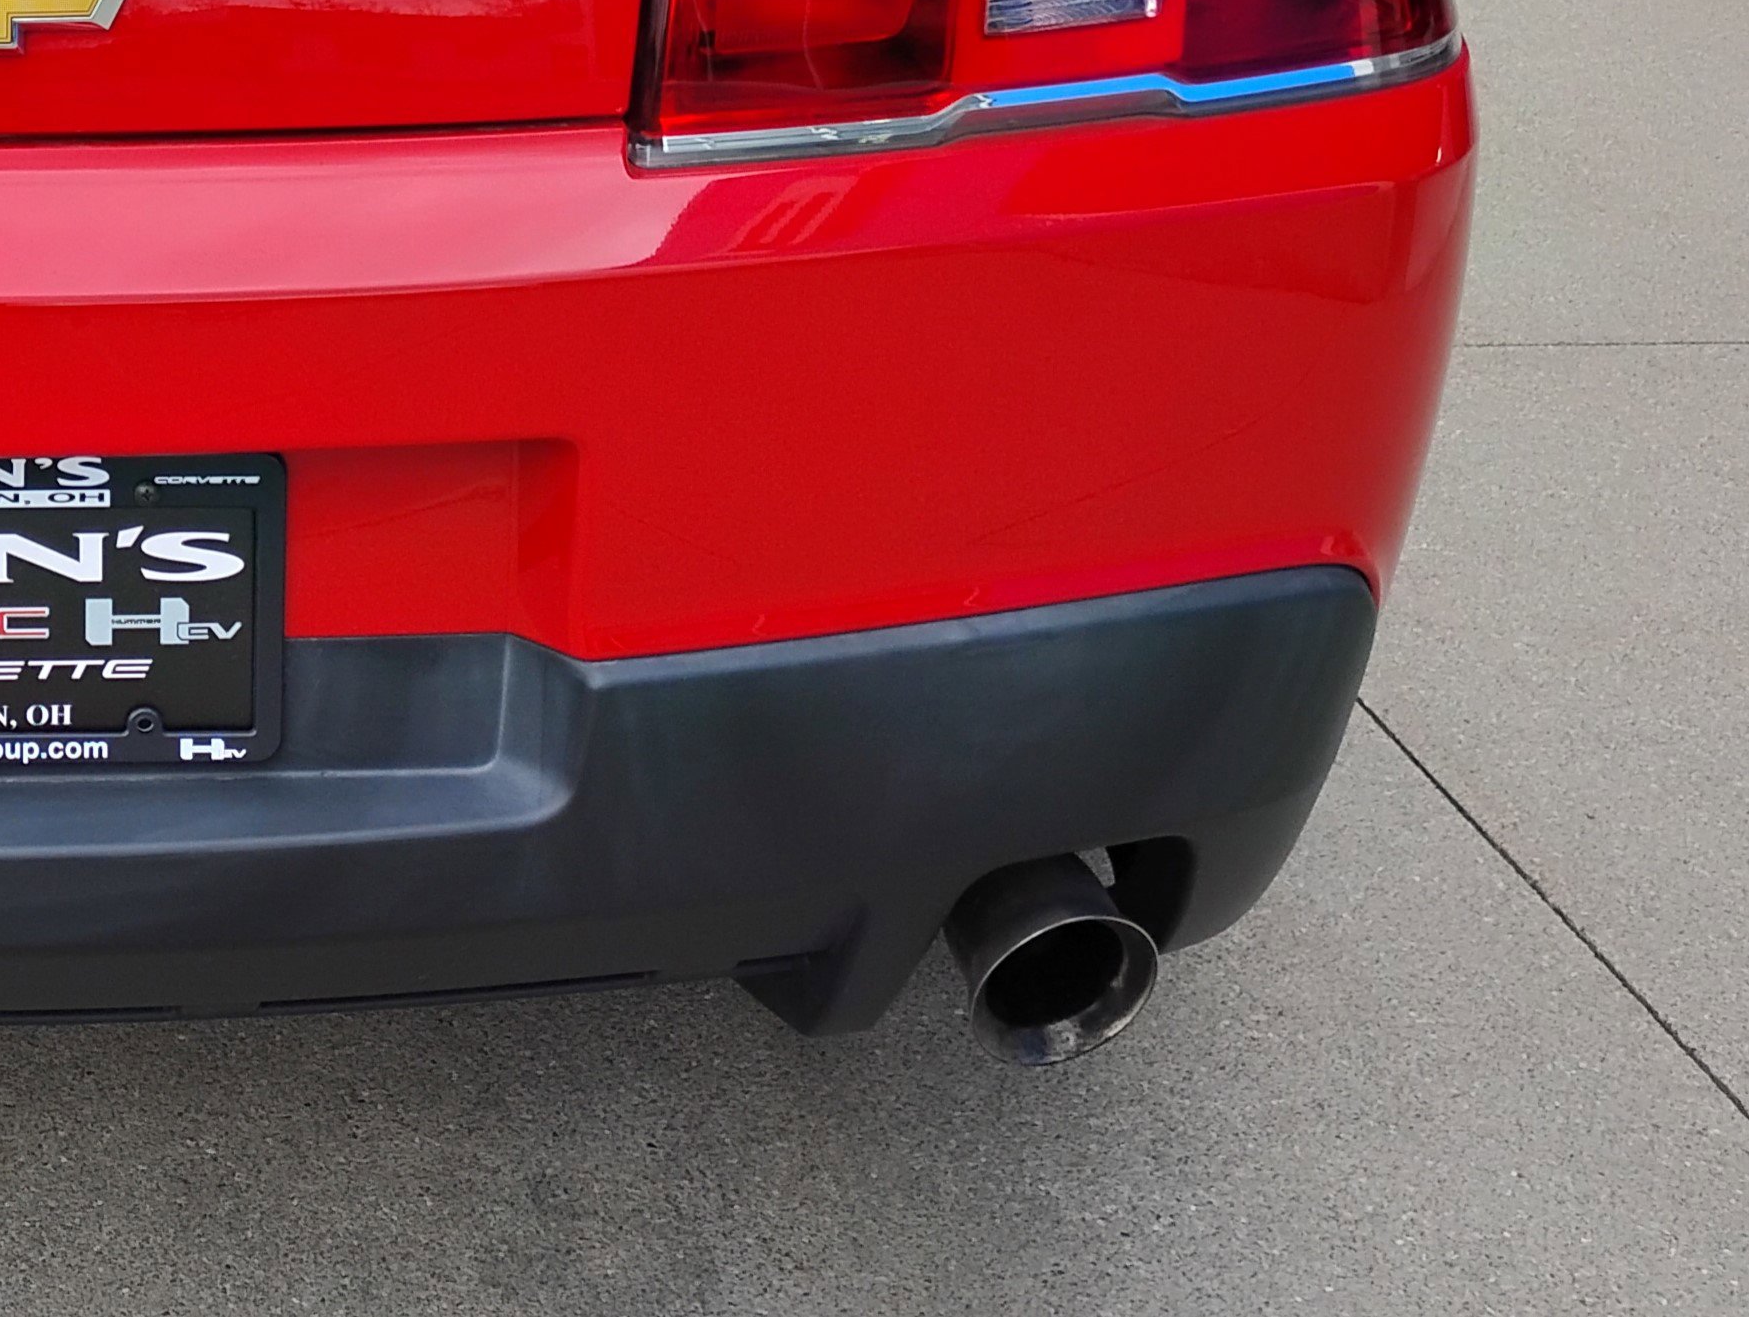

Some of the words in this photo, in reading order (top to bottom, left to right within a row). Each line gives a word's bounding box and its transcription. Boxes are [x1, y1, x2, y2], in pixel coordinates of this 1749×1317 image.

[153, 475, 261, 485] CORVETTE
[47, 491, 105, 504] OH
[25, 704, 73, 726] OH
